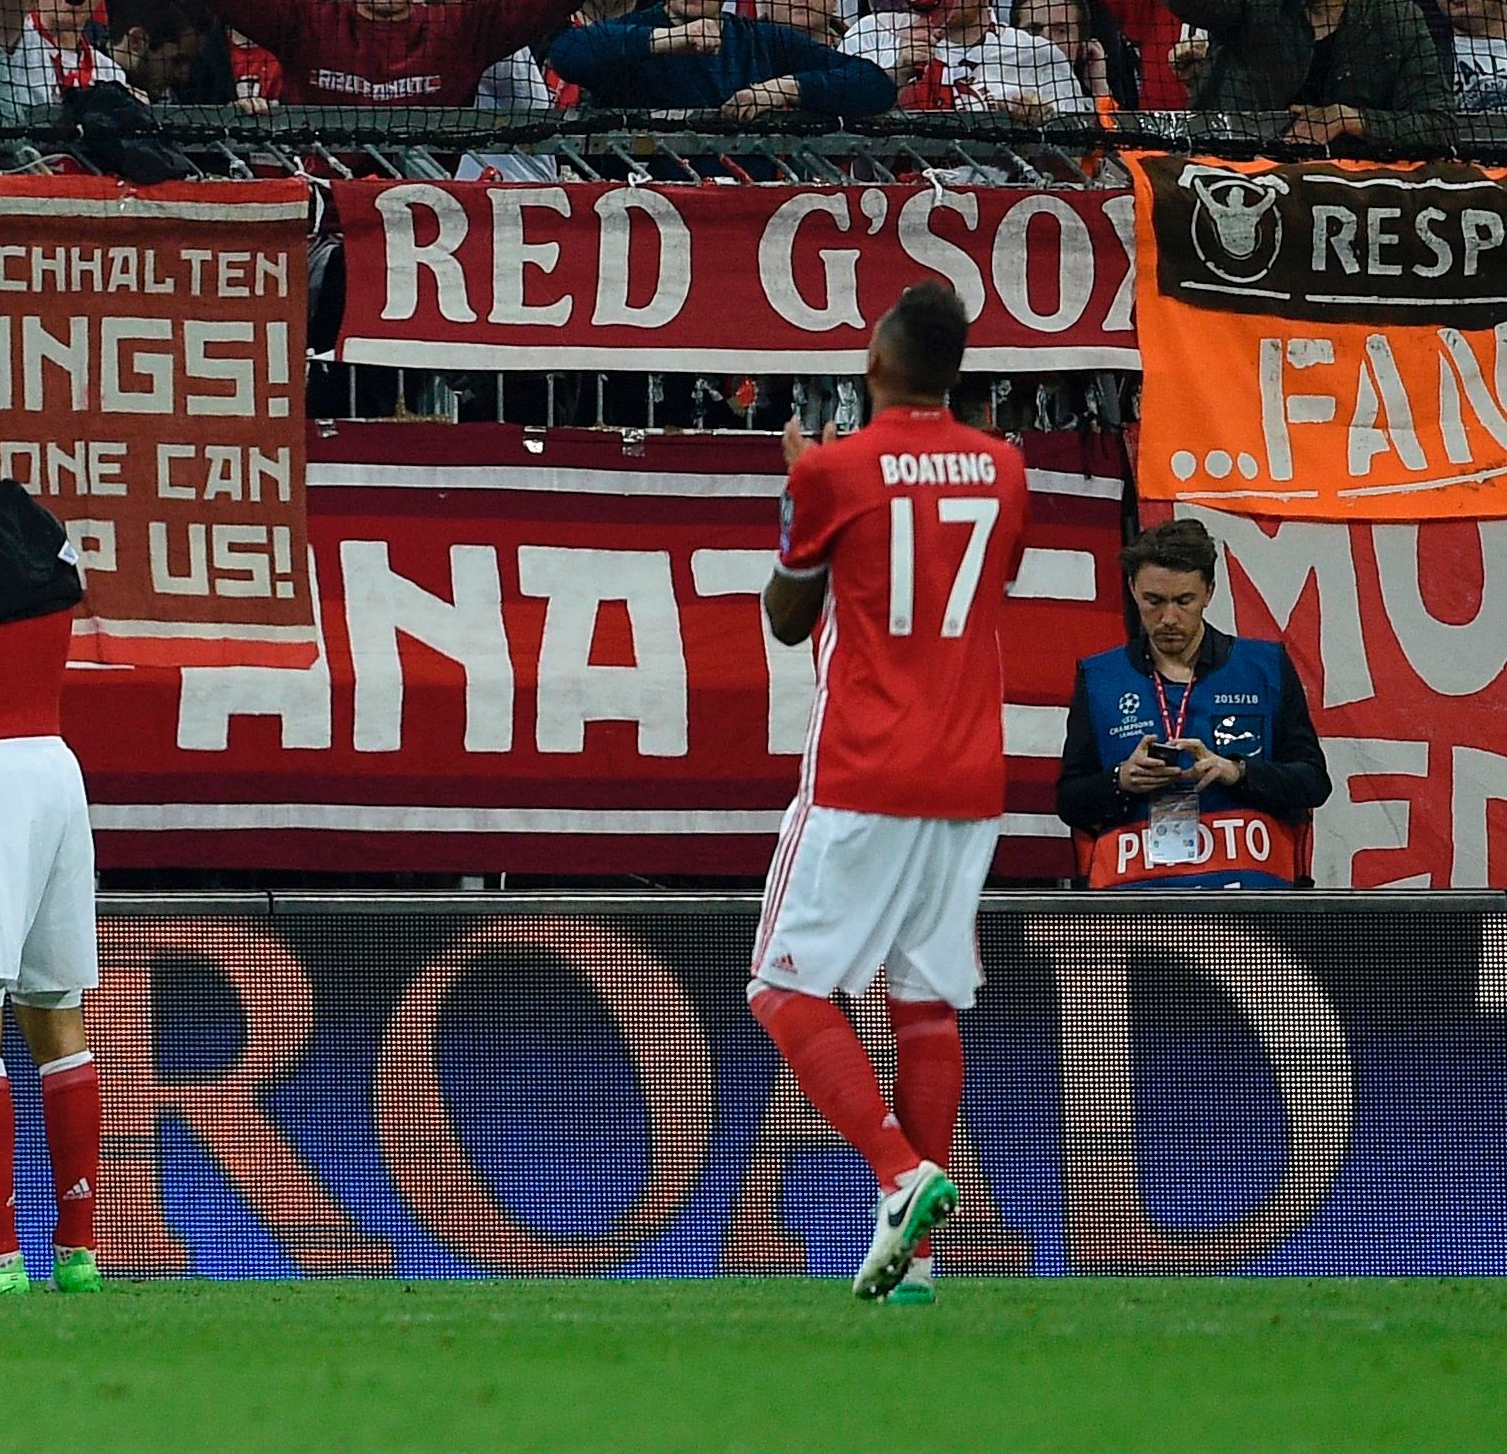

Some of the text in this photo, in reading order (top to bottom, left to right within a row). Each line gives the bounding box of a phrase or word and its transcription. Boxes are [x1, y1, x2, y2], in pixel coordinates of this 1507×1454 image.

[375, 183, 692, 330] RED
[1311, 202, 1504, 279] RESP
[0, 439, 291, 502] ONE CAN
[879, 452, 996, 487] BOATENG
[148, 521, 296, 599] US!
[889, 497, 1001, 638] 17
[1109, 719, 1155, 736] CHAMPIONS
